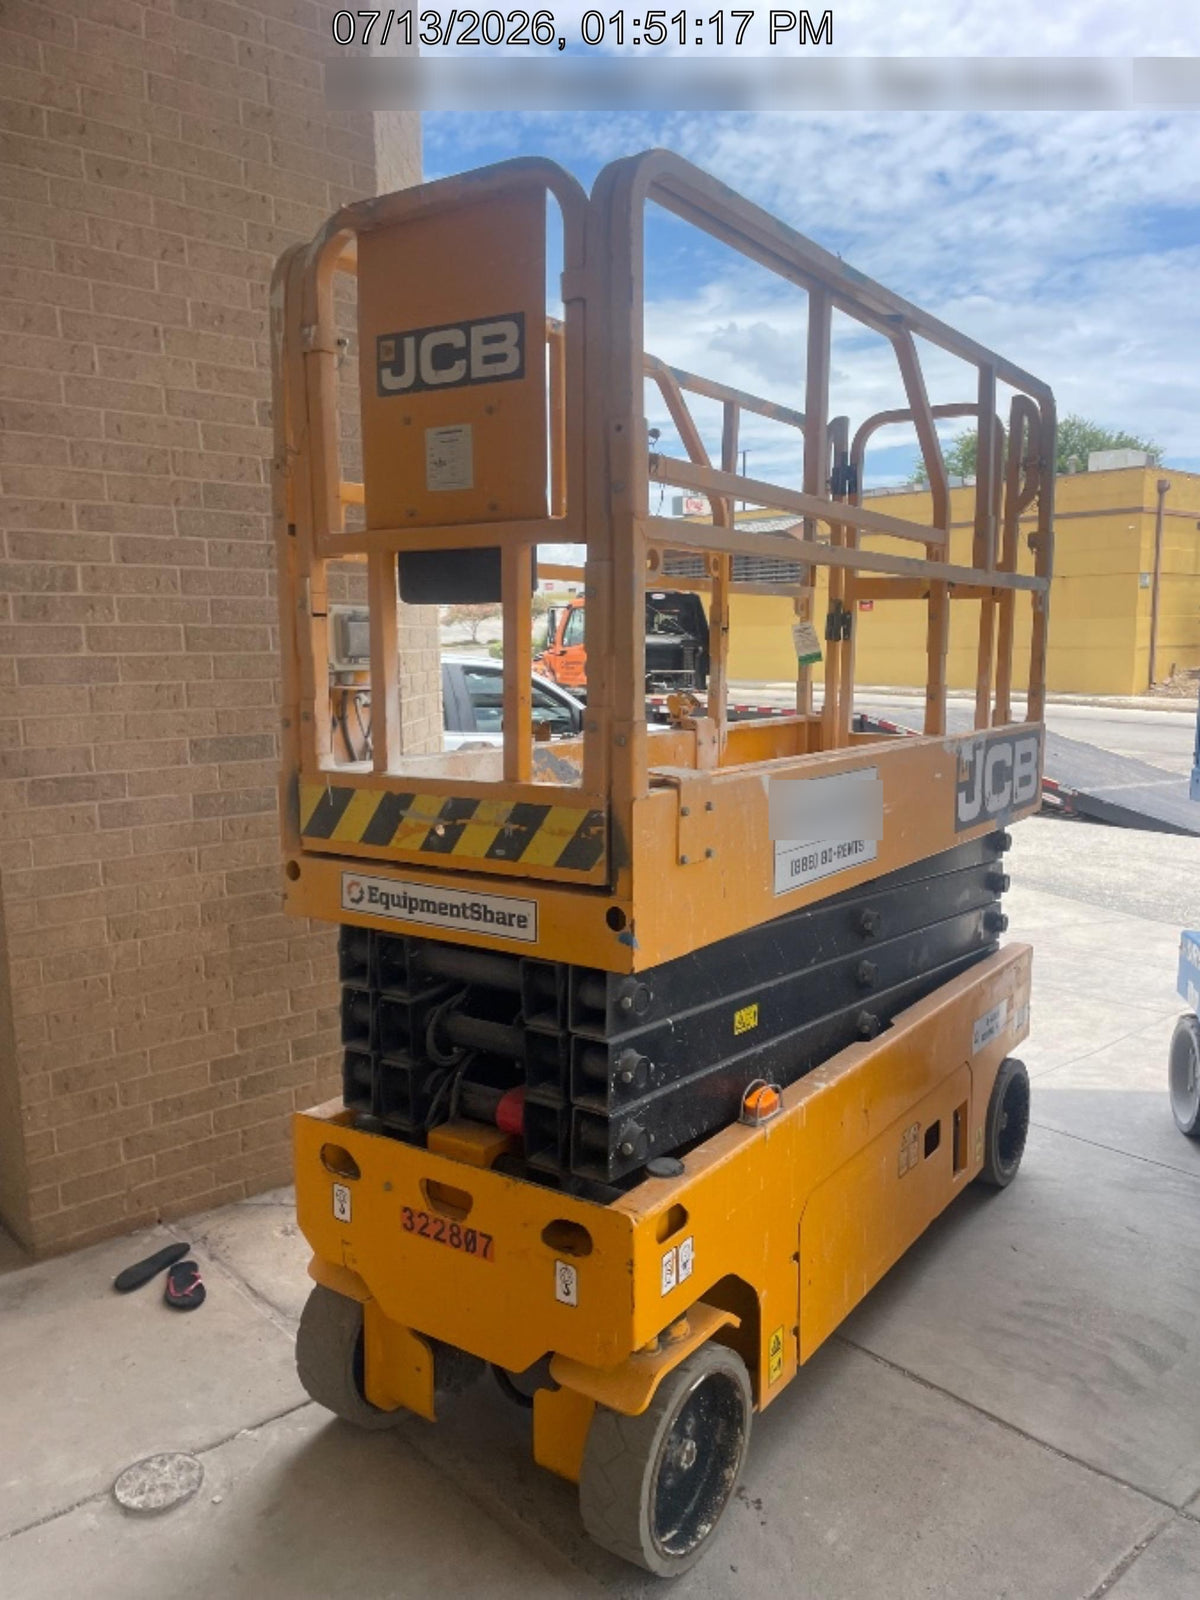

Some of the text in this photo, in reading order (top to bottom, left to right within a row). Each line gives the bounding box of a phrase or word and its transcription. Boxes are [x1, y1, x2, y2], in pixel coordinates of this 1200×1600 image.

[380, 320, 520, 391] JCB
[957, 736, 1038, 822] JCB
[366, 884, 529, 929] EquipmentShare
[401, 1206, 493, 1259] 322807
